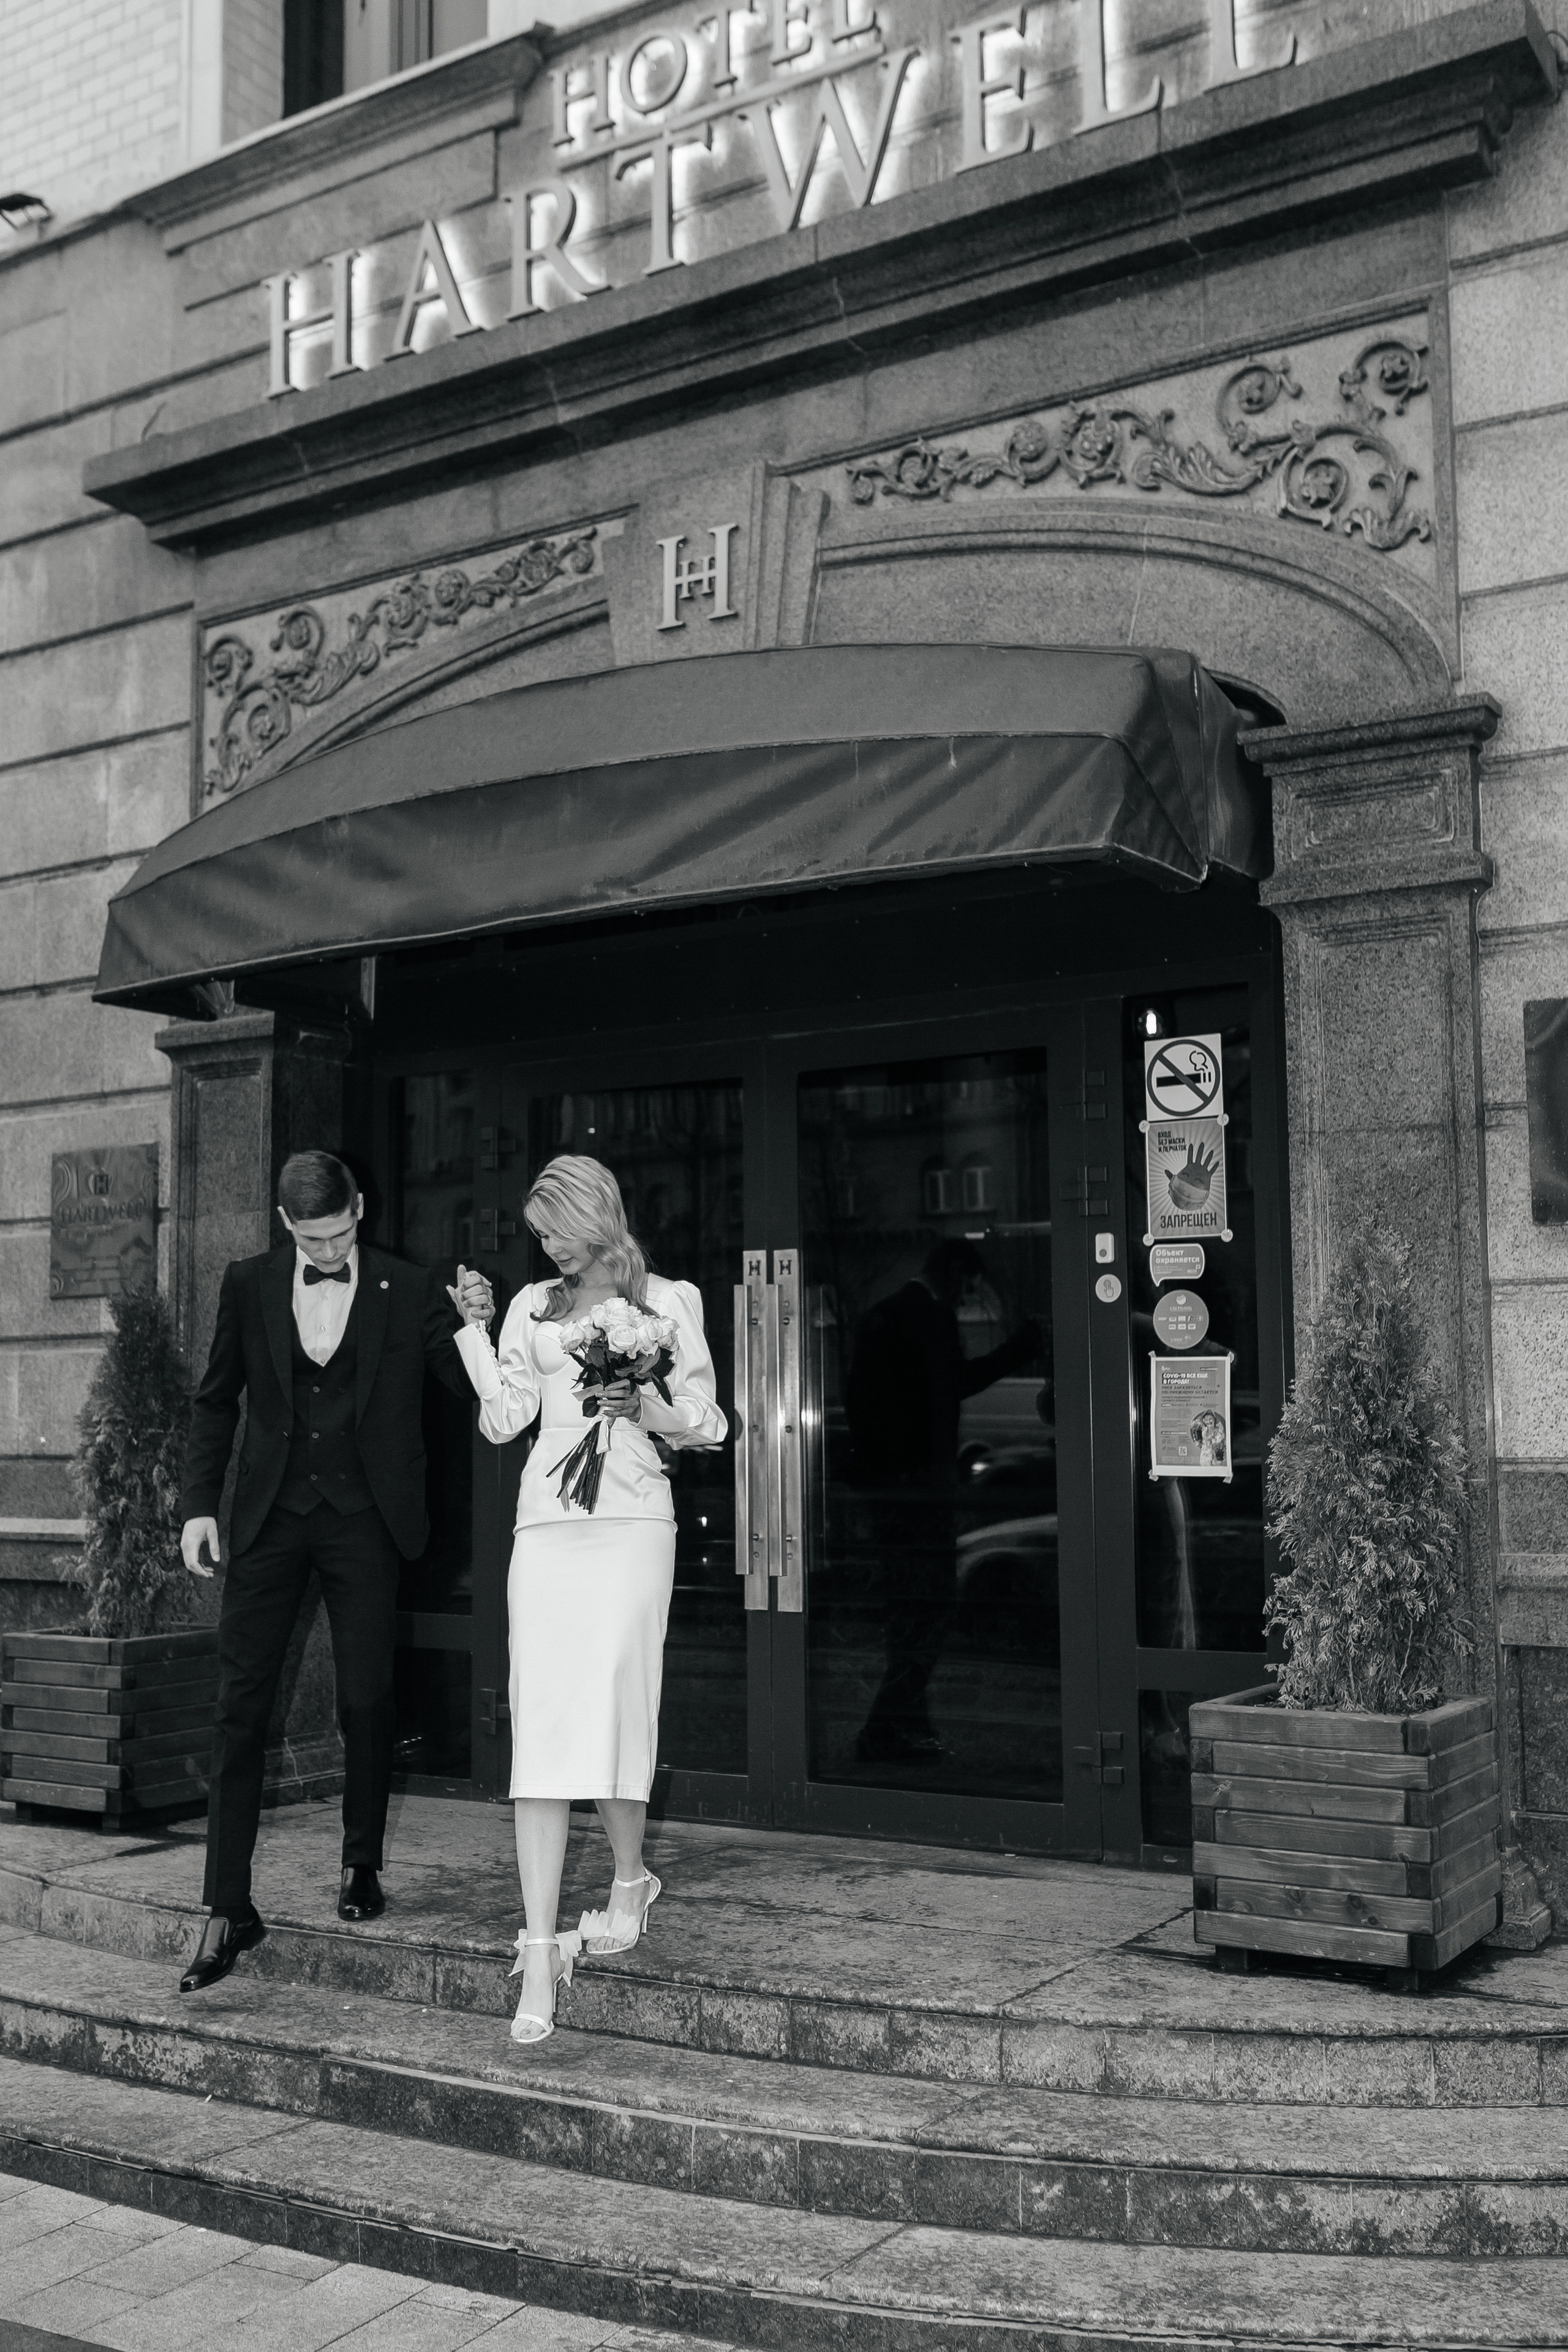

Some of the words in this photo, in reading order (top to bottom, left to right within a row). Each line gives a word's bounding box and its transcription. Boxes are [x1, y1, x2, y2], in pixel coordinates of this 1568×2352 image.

[550, 0, 880, 148] HOTEL
[262, 0, 1297, 399] HARTWELL
[1163, 1144, 1187, 1153] ПЕРЧАТОК
[1160, 1212, 1217, 1229] ЗАПРЕЩЕН
[1156, 1256, 1200, 1265] охраняется
